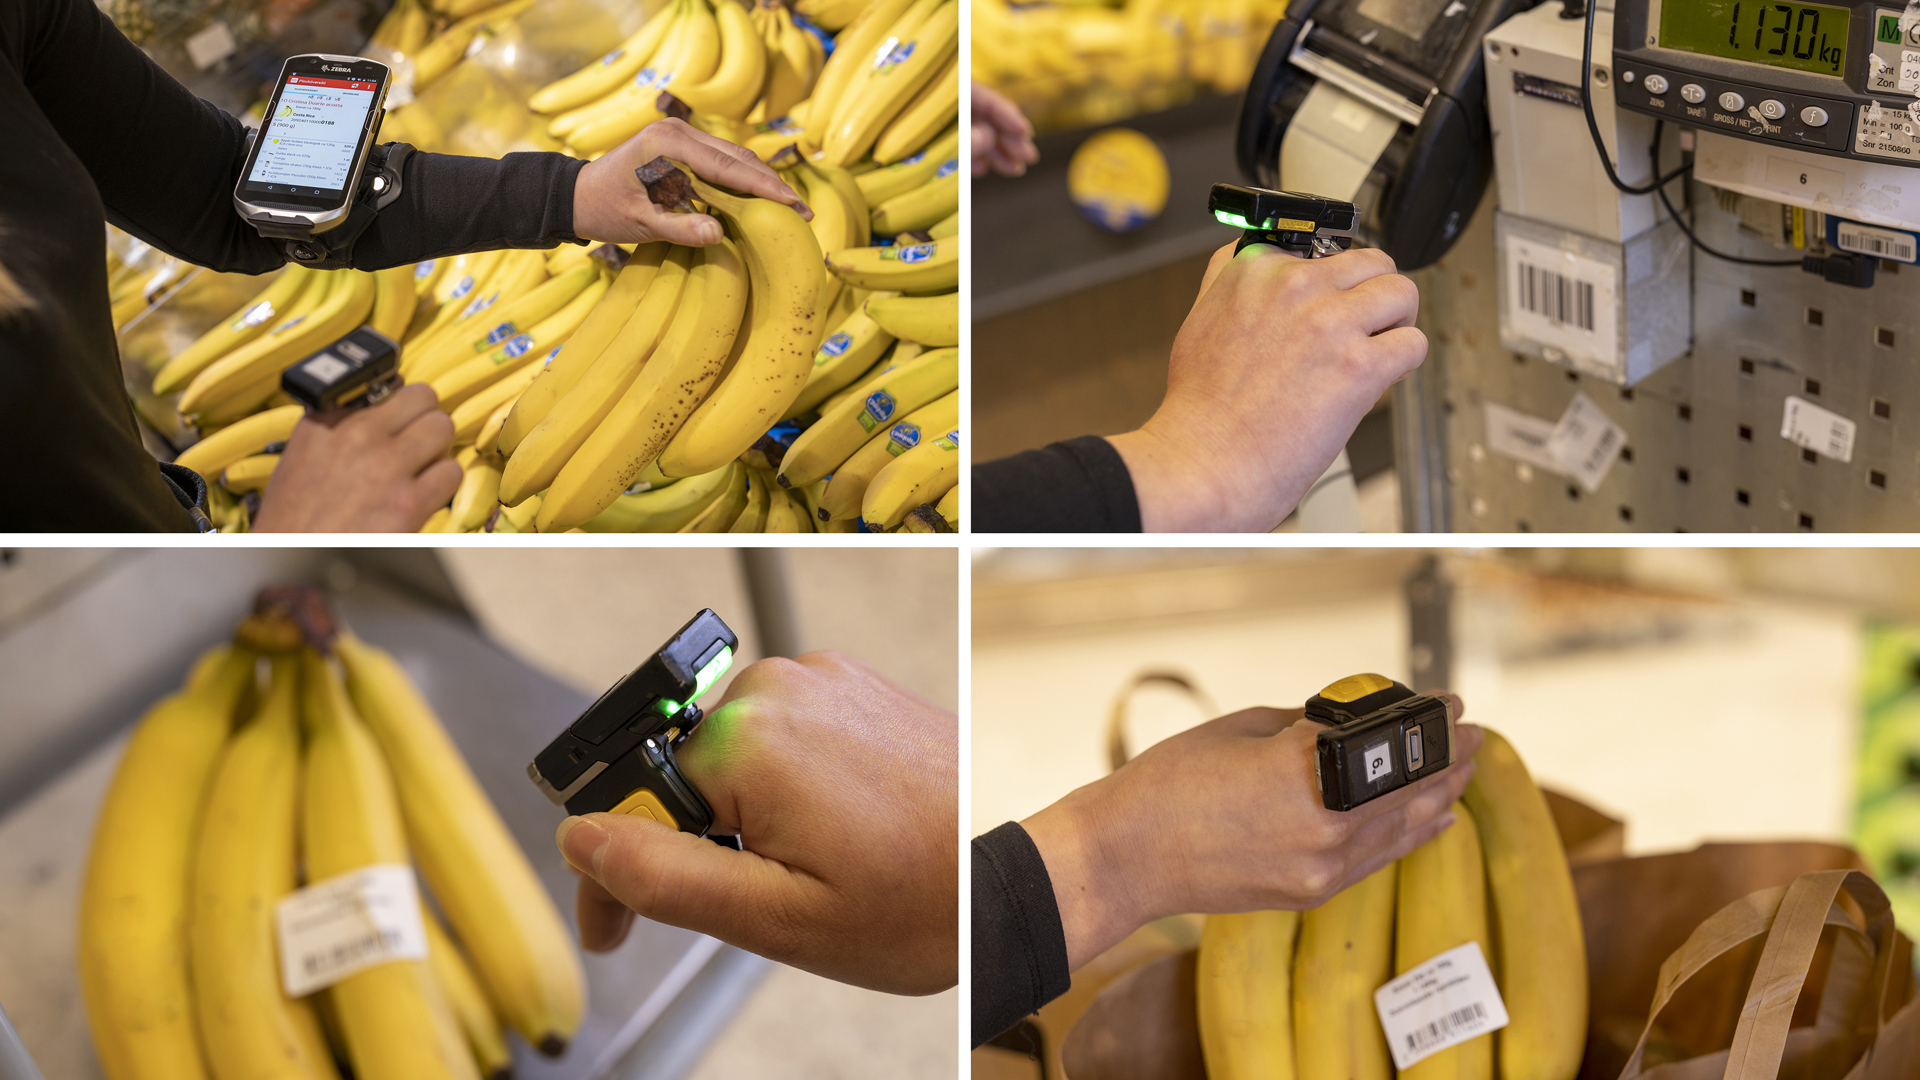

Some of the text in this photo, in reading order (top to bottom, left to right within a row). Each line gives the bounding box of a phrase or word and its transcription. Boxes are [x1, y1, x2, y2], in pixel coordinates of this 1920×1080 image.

[1882, 19, 1900, 40] M
[1877, 78, 1894, 88] Zon
[1650, 97, 1665, 108] ZERO
[1686, 107, 1701, 118] TARE
[1714, 113, 1734, 125] GROSS
[1740, 119, 1751, 128] NET
[1890, 123, 1903, 131] 100
[1863, 140, 1875, 148] Snr
[1800, 173, 1807, 184] 6
